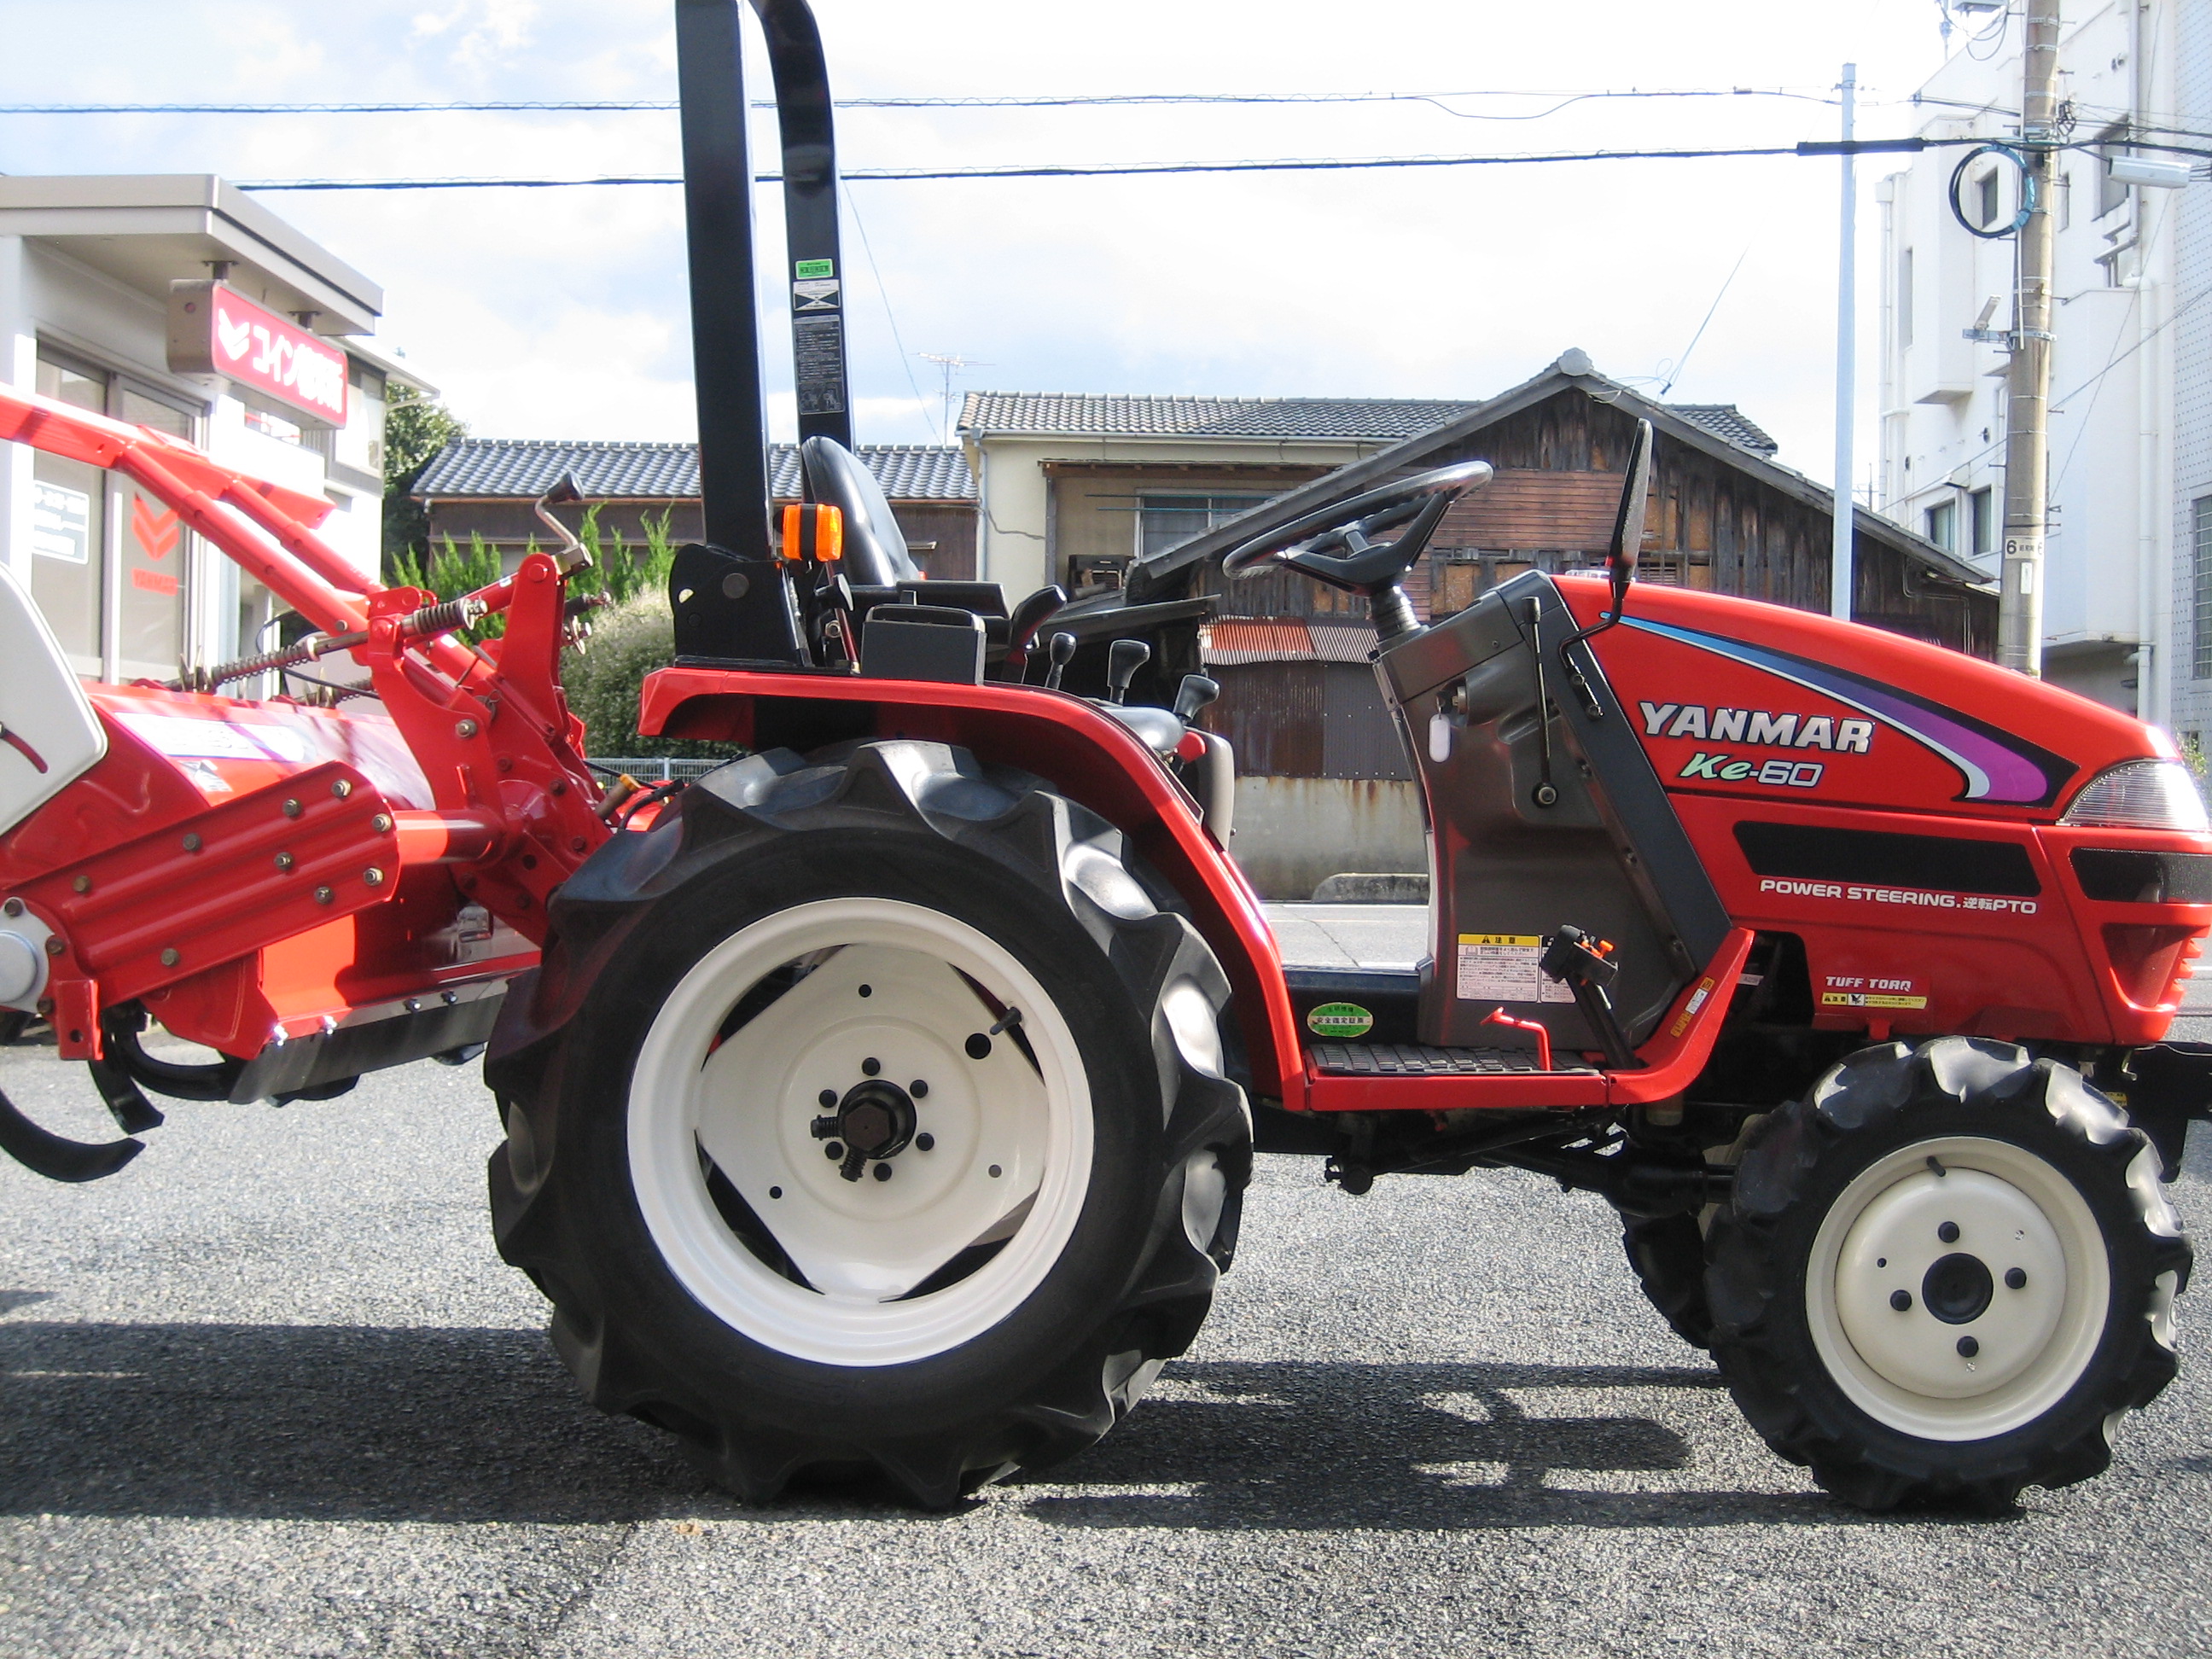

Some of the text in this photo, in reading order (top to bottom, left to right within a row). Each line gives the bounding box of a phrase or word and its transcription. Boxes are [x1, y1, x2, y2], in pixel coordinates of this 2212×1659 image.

[2007, 539, 2017, 555] 6
[1639, 701, 1873, 753] YANMAR
[1679, 753, 1824, 787] Ke-60
[1761, 880, 1842, 898] POWER
[1826, 976, 1912, 992] TUFF TORQ
